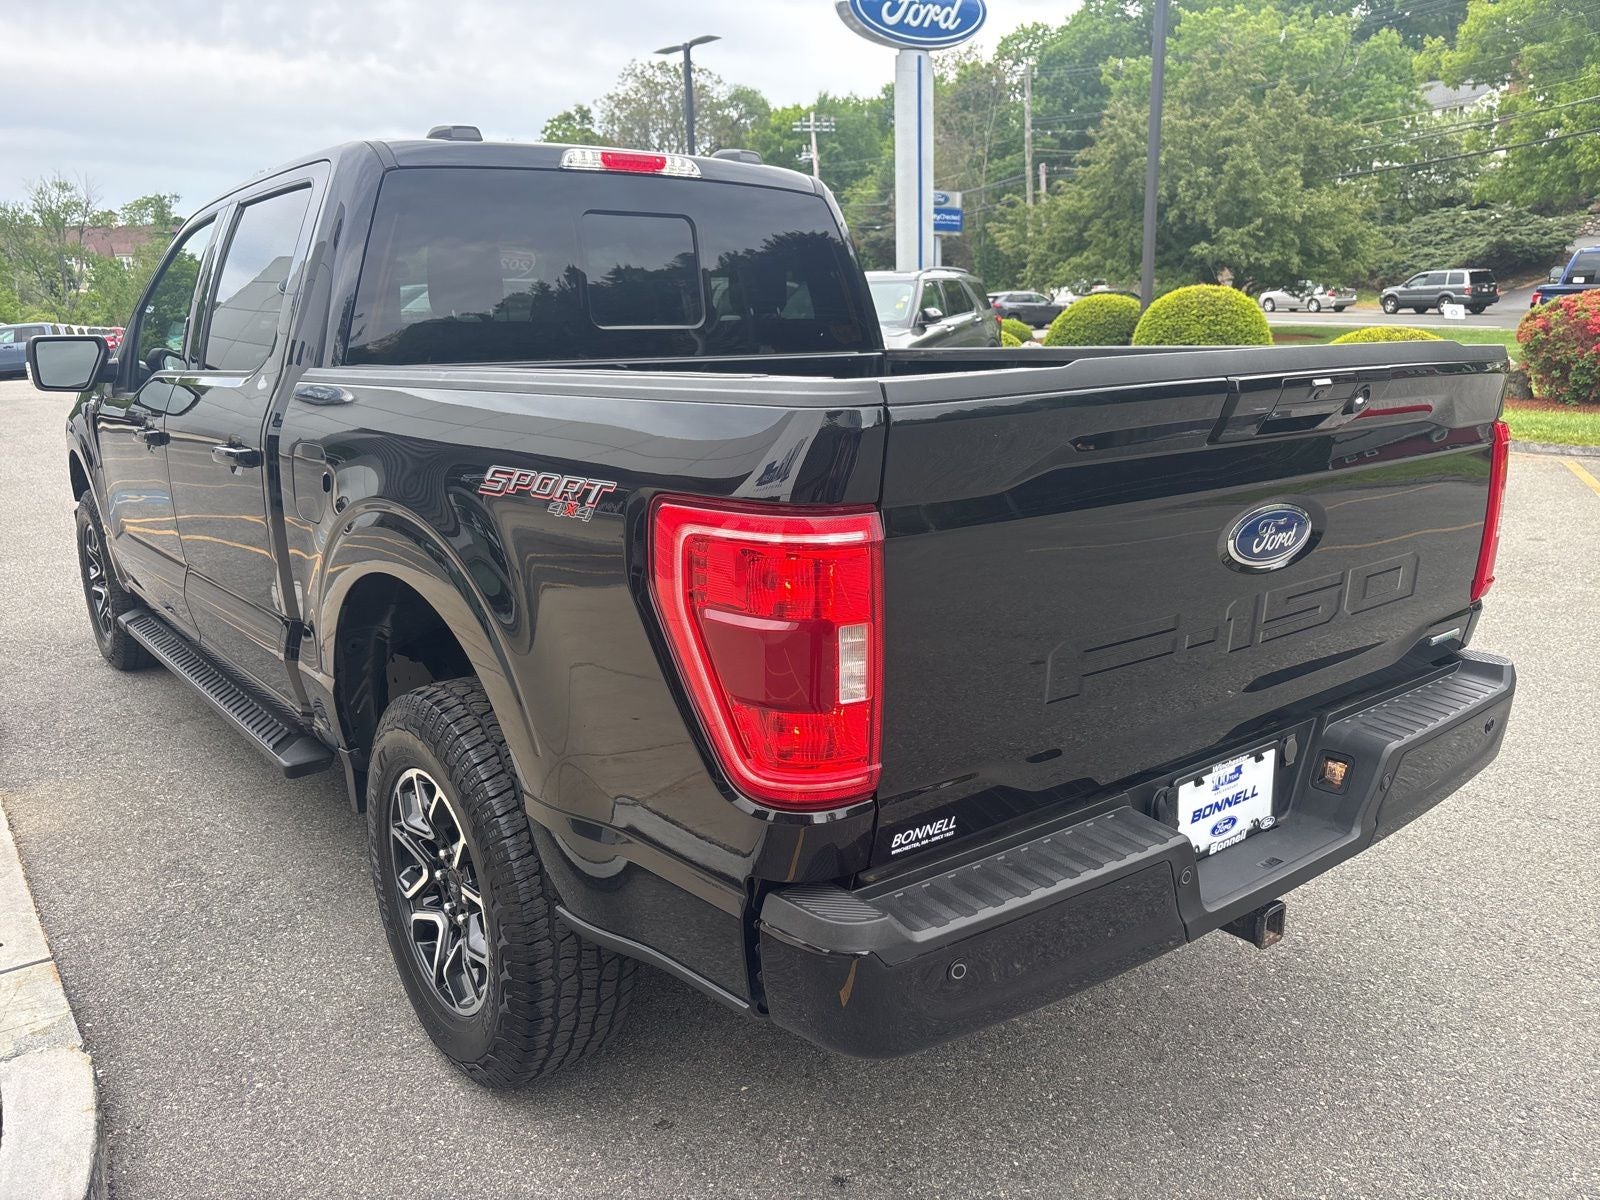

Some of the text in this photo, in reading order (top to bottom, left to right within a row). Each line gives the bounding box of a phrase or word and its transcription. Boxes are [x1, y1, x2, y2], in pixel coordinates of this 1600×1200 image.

[478, 464, 617, 507] SPORT
[1252, 517, 1297, 554] Ford
[1045, 551, 1419, 704] F-150
[1212, 754, 1250, 773] Winchester
[1190, 785, 1258, 824] BONNELL
[891, 815, 956, 848] BONNELL
[1208, 828, 1247, 855] Bonnell
[1214, 818, 1233, 832] Ford
